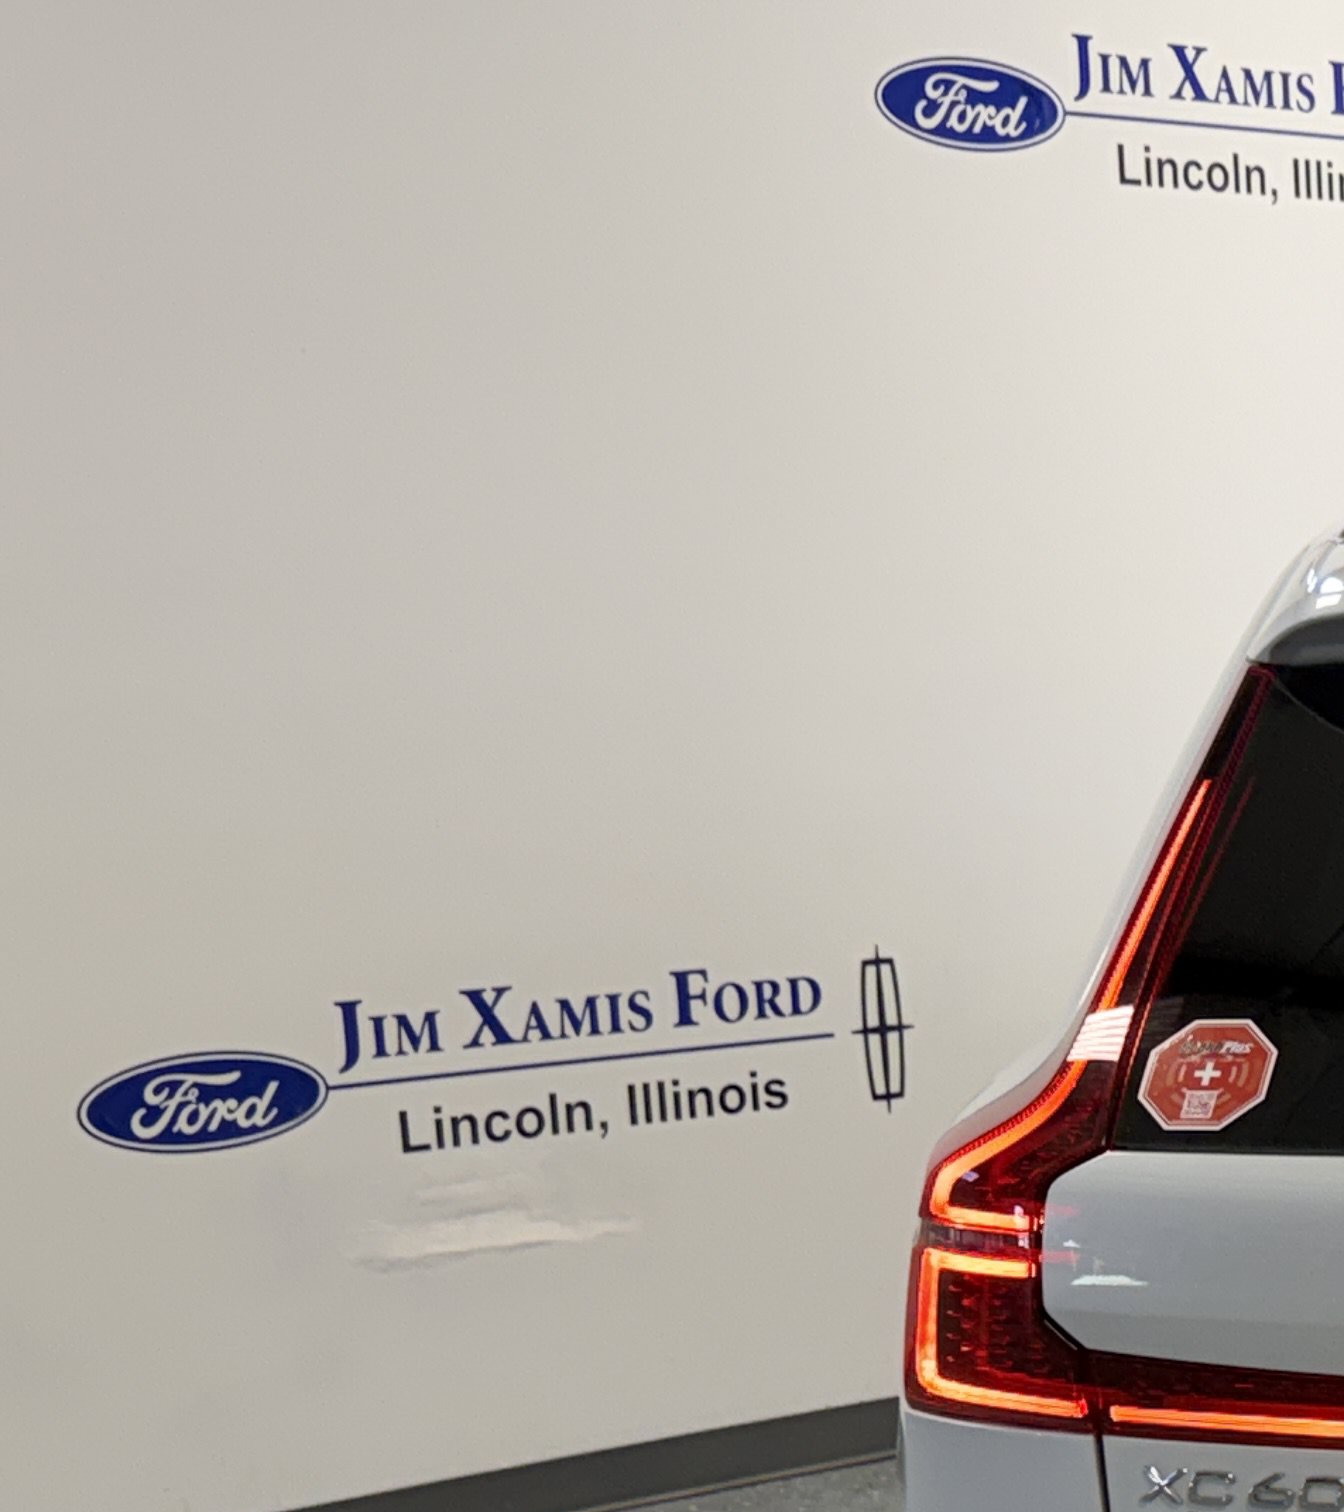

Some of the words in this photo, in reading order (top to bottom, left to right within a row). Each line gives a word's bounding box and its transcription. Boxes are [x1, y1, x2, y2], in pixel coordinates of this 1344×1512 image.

[914, 72, 1028, 137] Ford
[1071, 33, 1152, 101] JIM
[1168, 44, 1315, 113] XAMIS
[1116, 143, 1279, 204] Lincoln,
[333, 999, 443, 1073] JIM
[458, 986, 653, 1048] XAMIS
[669, 968, 823, 1027] FORD
[128, 1071, 280, 1139] Ford
[398, 1092, 610, 1154] Lincoln,
[626, 1070, 790, 1126] Illinois
